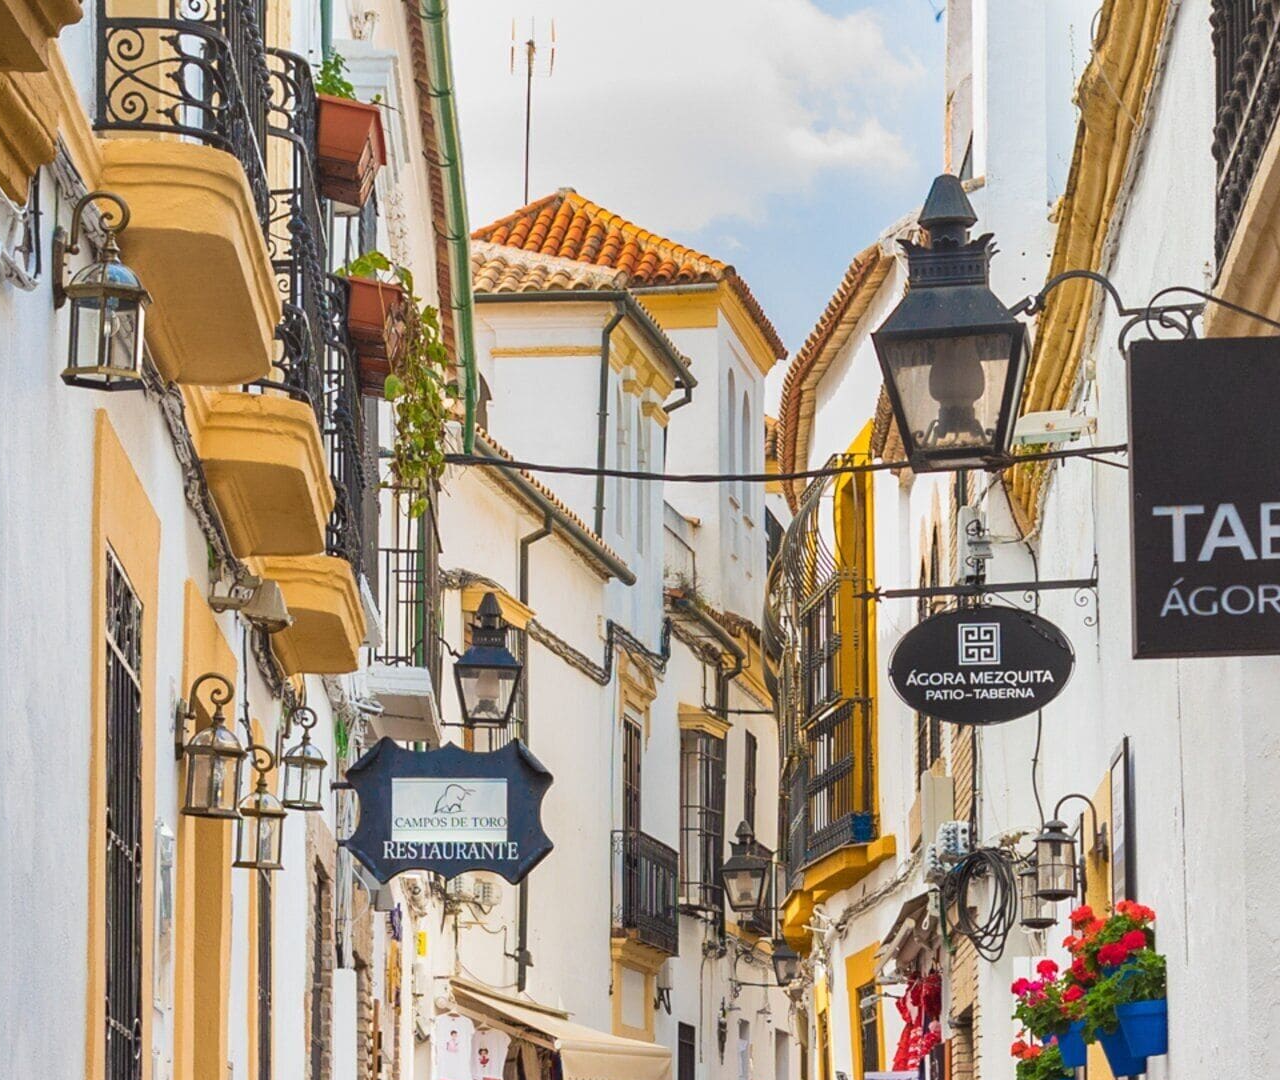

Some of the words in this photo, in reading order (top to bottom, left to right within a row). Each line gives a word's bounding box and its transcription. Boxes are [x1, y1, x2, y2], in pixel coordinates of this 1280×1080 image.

[905, 669, 966, 686] ÁGORA
[969, 669, 1054, 686] MEZQUITA
[394, 816, 448, 829] CAMPOS
[450, 816, 469, 828] DE
[472, 816, 508, 828] TORO
[382, 840, 520, 861] RESTAURANTE
